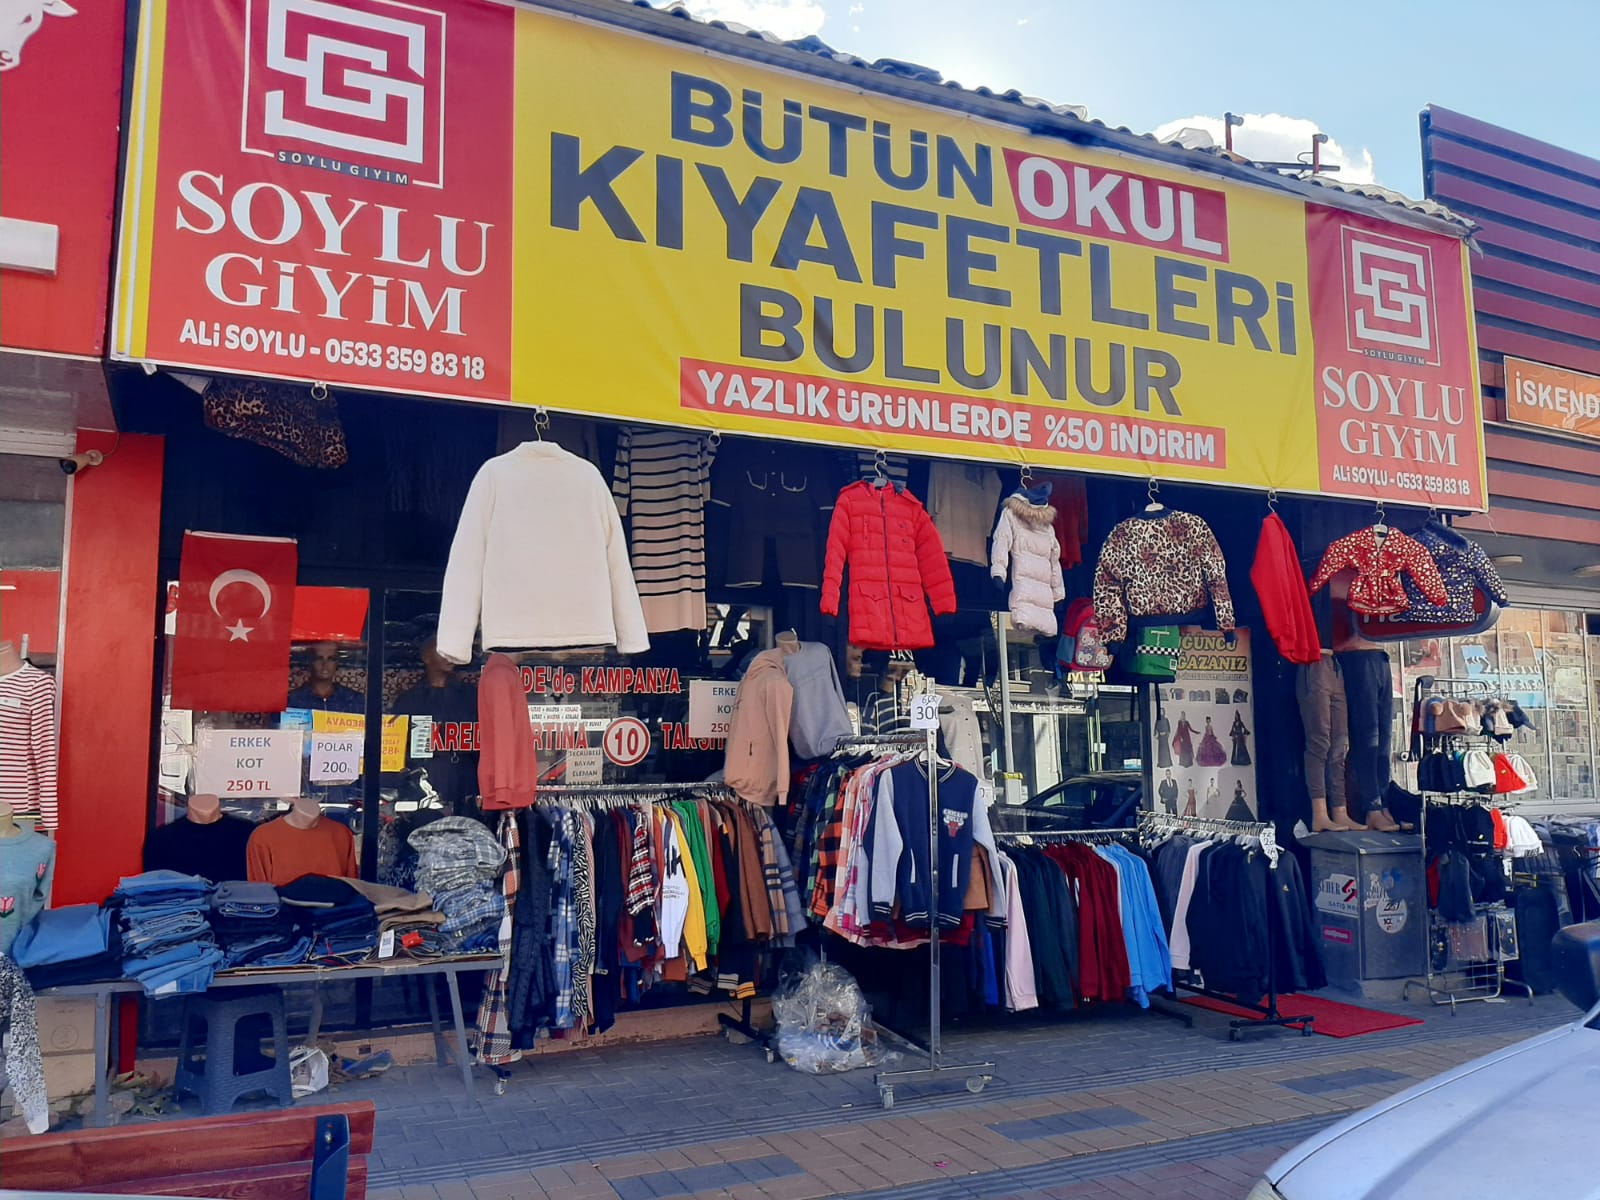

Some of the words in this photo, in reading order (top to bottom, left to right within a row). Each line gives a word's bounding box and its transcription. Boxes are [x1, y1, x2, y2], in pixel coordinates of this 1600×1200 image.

[279, 151, 341, 171] SOYLU
[671, 71, 993, 207] BÜTÜN
[1017, 156, 1223, 255] OKUL
[176, 170, 494, 277] SOYLU
[550, 131, 1297, 355] KIYAFETLERİ
[225, 324, 305, 358] SOYLU
[327, 338, 381, 368] 0533
[385, 344, 427, 373] 359
[431, 351, 460, 376] 83
[462, 354, 485, 380] 18
[739, 283, 1183, 416] BULUNUR
[1322, 366, 1465, 425] SOYLU
[697, 368, 830, 419] YAZLIK
[836, 389, 1032, 442] ÜRÜNLERDE
[1044, 414, 1104, 452] %50
[1352, 467, 1388, 486] SOYLU
[1396, 471, 1423, 490] 0533
[1424, 475, 1443, 493] 359
[1444, 479, 1457, 495] 83
[1459, 480, 1471, 495] 18
[581, 666, 681, 694] KAMPANYA
[713, 688, 737, 696] ERKE
[718, 705, 732, 714] KO
[230, 737, 272, 747] ERKEK
[317, 743, 353, 752] POLAR
[430, 722, 480, 752] KRED
[531, 722, 589, 750] RTINA
[615, 728, 639, 755] 10
[236, 758, 264, 769] KOT
[322, 762, 347, 773] 200
[227, 780, 254, 791] 250
[257, 780, 271, 791] TL
